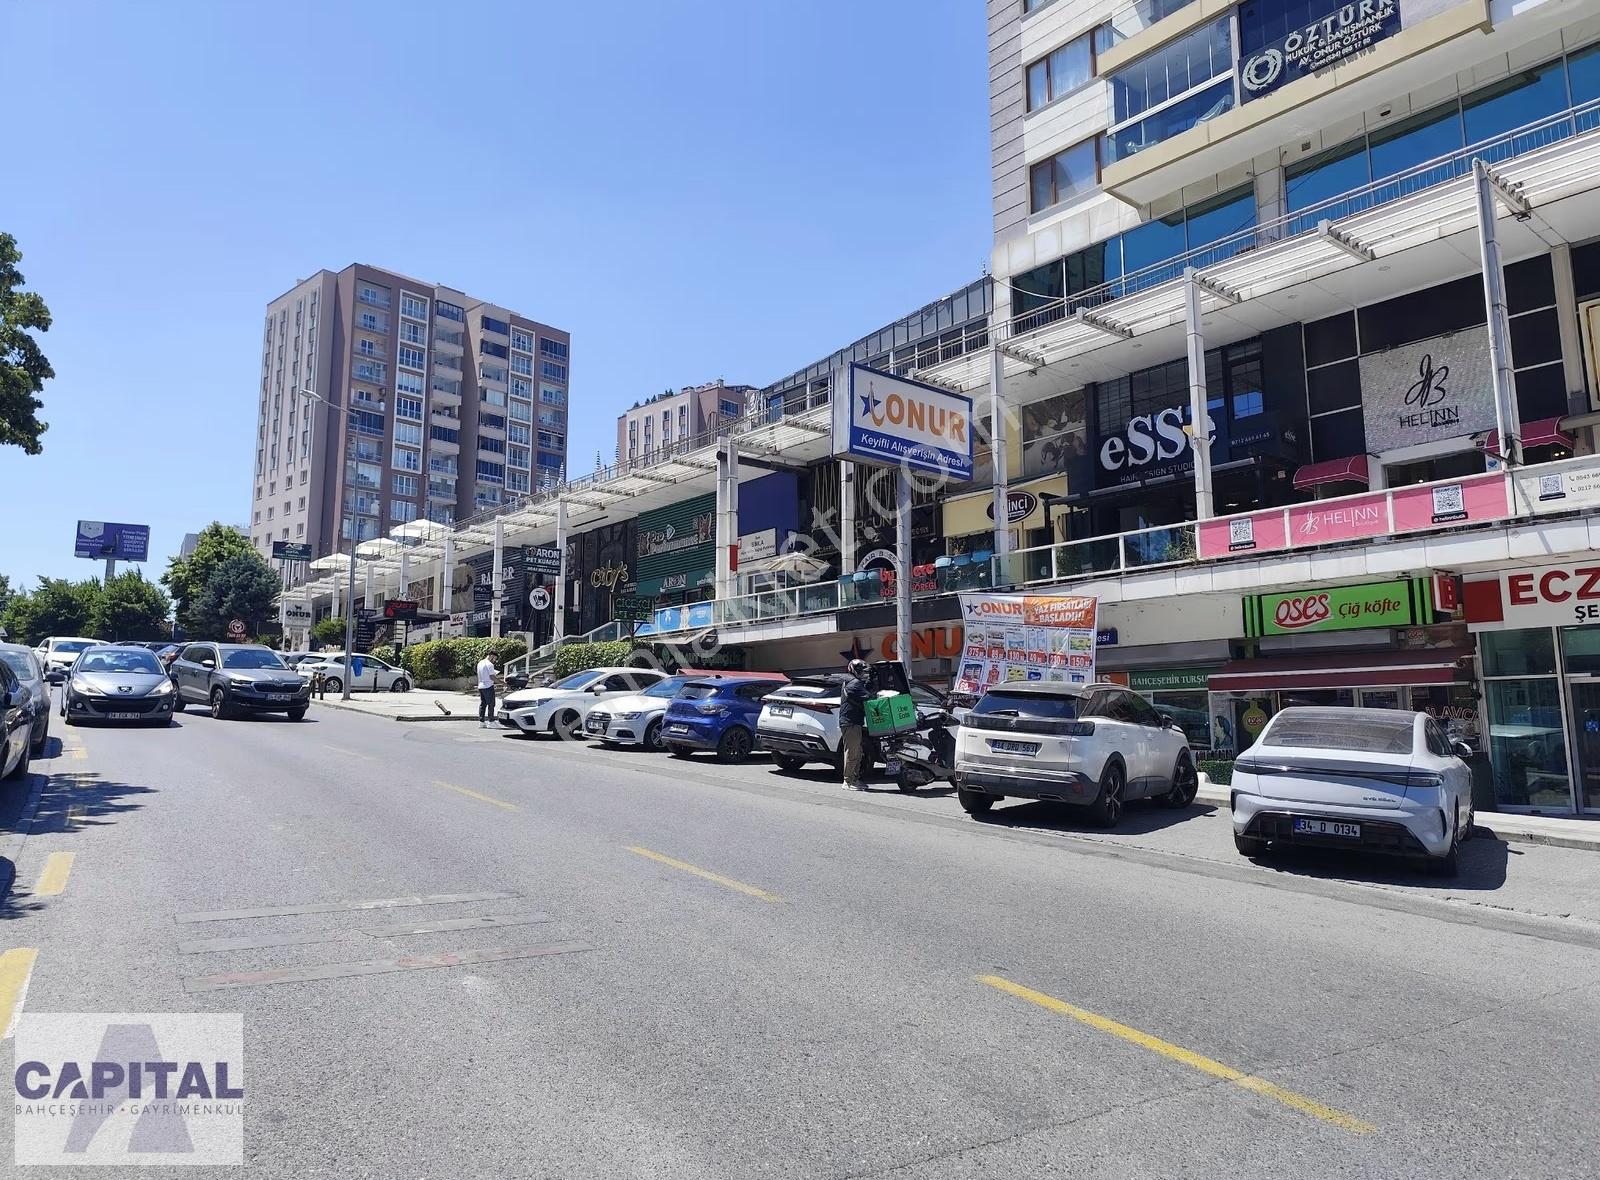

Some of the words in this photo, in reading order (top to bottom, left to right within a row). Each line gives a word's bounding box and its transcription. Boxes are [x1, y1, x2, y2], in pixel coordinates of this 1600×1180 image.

[1286, 41, 1317, 64] HUKUK
[1327, 4, 1394, 44] DANIŞMANLIK
[1313, 41, 1341, 60] ONUR
[1342, 21, 1383, 46] ÖZTÜRK
[886, 393, 966, 443] ONUR
[861, 433, 890, 452] Keyifli
[890, 440, 936, 461] Alışverişin
[936, 451, 964, 468] Adresi
[1008, 495, 1028, 513] İNCİ
[536, 549, 560, 559] ARON
[481, 566, 515, 585] BAER
[980, 602, 1022, 615] ONUR
[1338, 602, 1361, 619] Çiğ
[1364, 597, 1401, 614] köfte
[881, 627, 963, 661] ONU
[1096, 633, 1110, 643] esi
[1131, 674, 1180, 687] BAHÇEŞEHİR
[1300, 820, 1313, 831] 34
[1334, 822, 1358, 836] 0134
